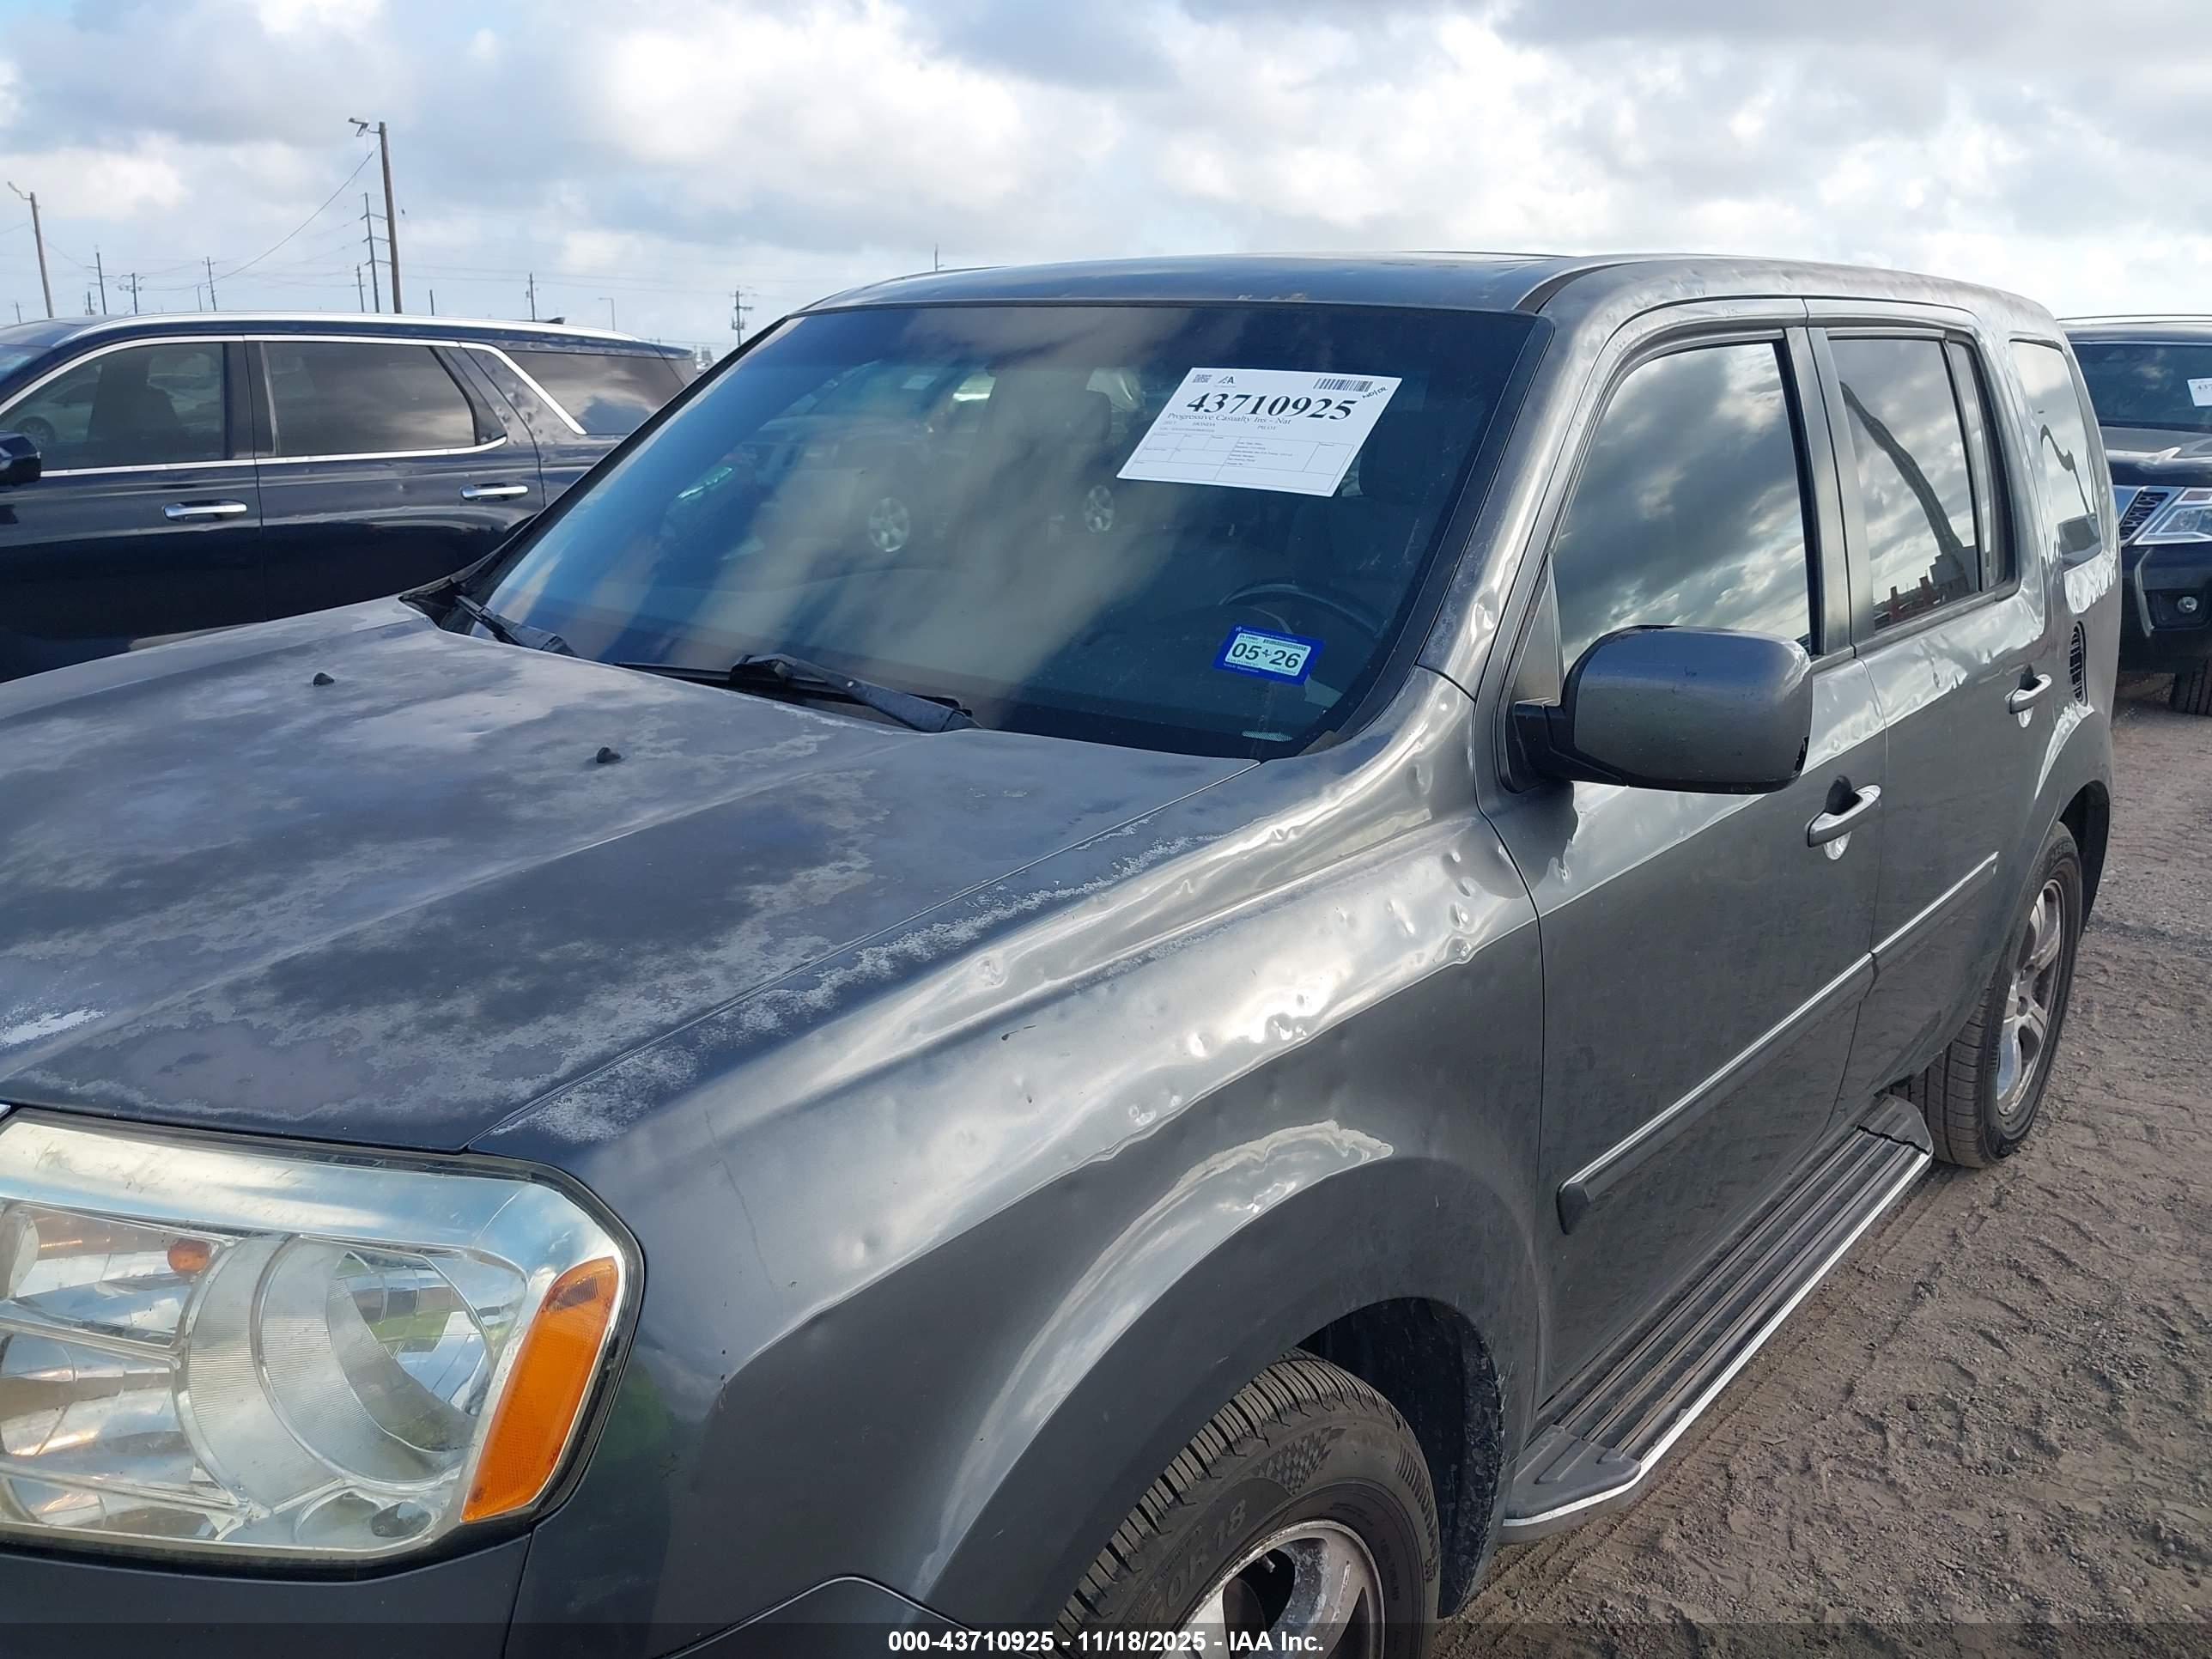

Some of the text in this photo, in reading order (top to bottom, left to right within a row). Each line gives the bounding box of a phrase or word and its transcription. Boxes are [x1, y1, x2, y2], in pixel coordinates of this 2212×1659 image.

[1167, 412, 1214, 421] Progressive
[1216, 414, 1251, 423] Casualty
[1186, 392, 1358, 420] 43710925
[1232, 643, 1261, 660] 05
[1268, 650, 1301, 668] 26
